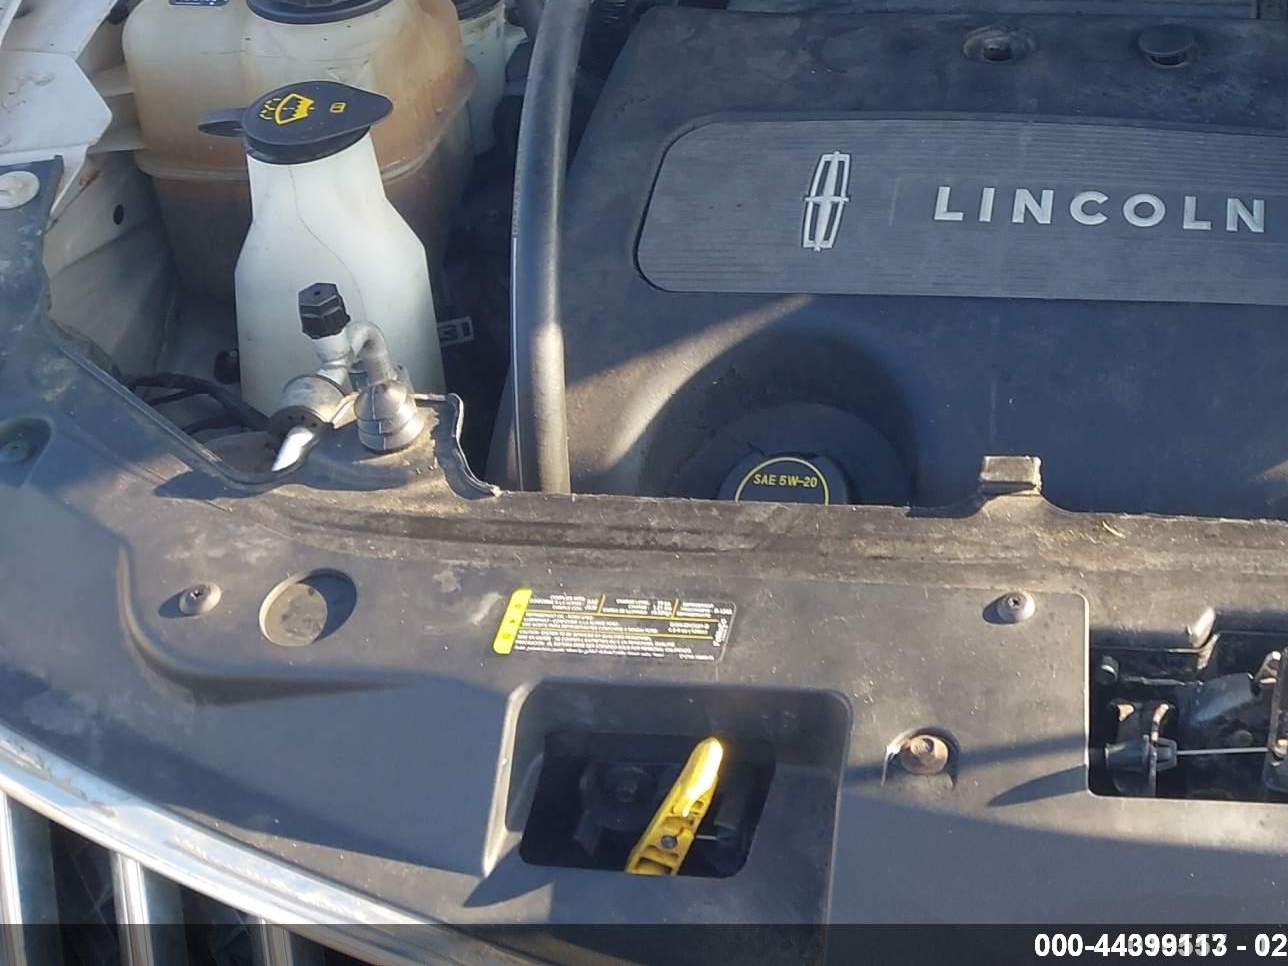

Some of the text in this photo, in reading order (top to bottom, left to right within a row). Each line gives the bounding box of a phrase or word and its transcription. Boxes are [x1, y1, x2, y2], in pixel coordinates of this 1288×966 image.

[933, 185, 1265, 233] LINCOLN
[753, 474, 818, 488] SAE 5W-20
